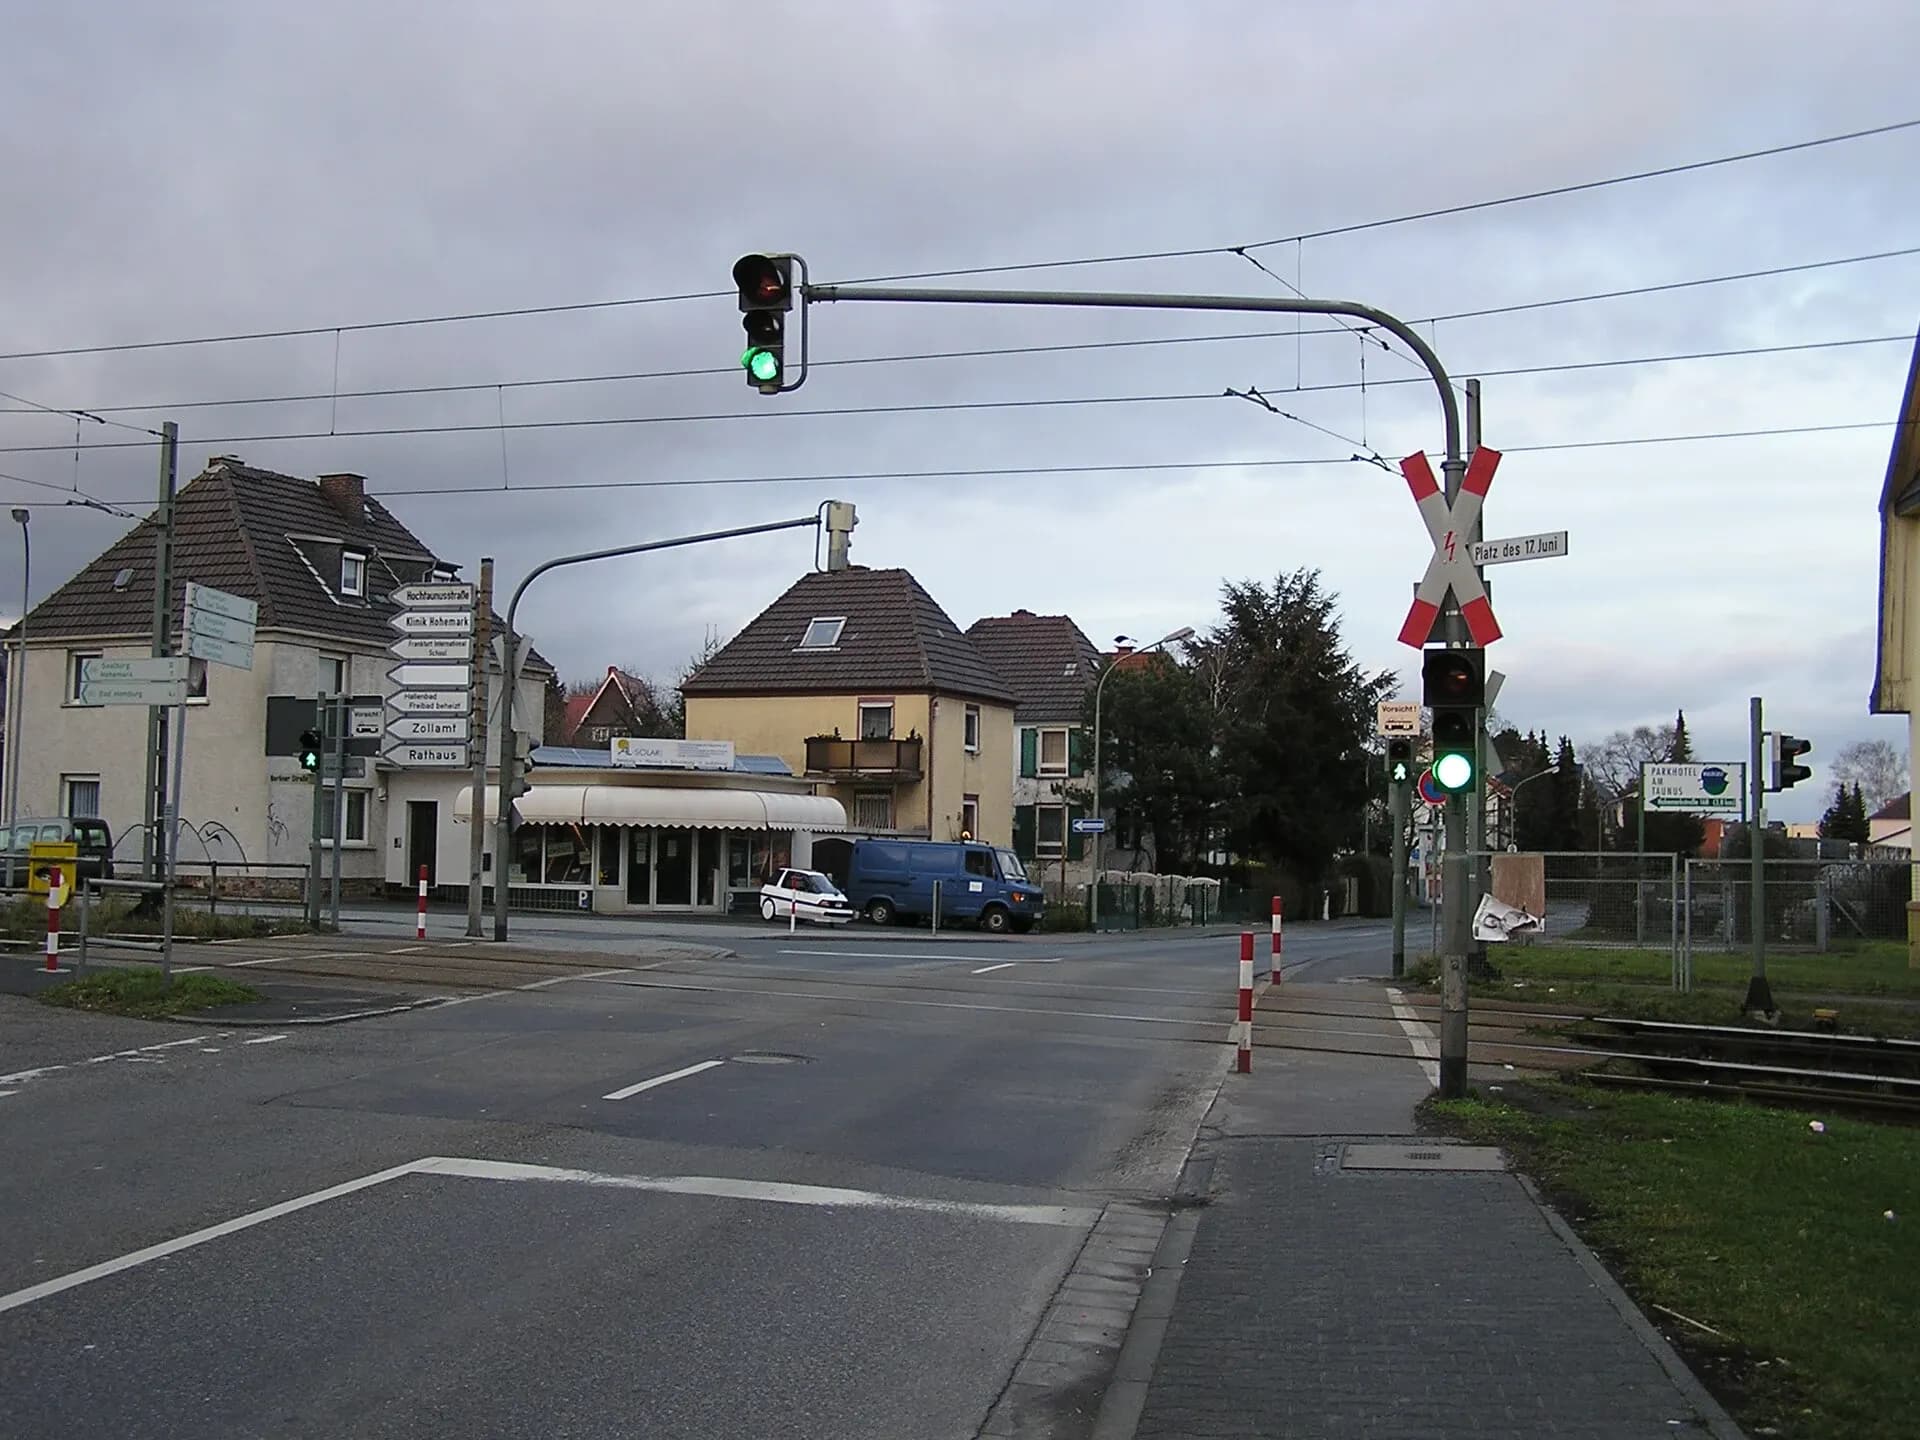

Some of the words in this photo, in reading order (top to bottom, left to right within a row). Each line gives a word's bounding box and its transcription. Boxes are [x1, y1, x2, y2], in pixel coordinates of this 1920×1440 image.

[1475, 546, 1498, 561] Platz
[1502, 543, 1521, 557] des
[1537, 536, 1558, 552] Juni
[406, 590, 469, 601] Hochtaunusstraße
[406, 616, 427, 626] Klinik
[429, 616, 469, 626] Hohemark
[412, 723, 457, 733] Zollamt
[409, 750, 457, 760] Rathaus
[1651, 767, 1697, 776] PARKHOTEL
[1652, 777, 1664, 785] AM
[1652, 787, 1683, 795] TAUNUS
